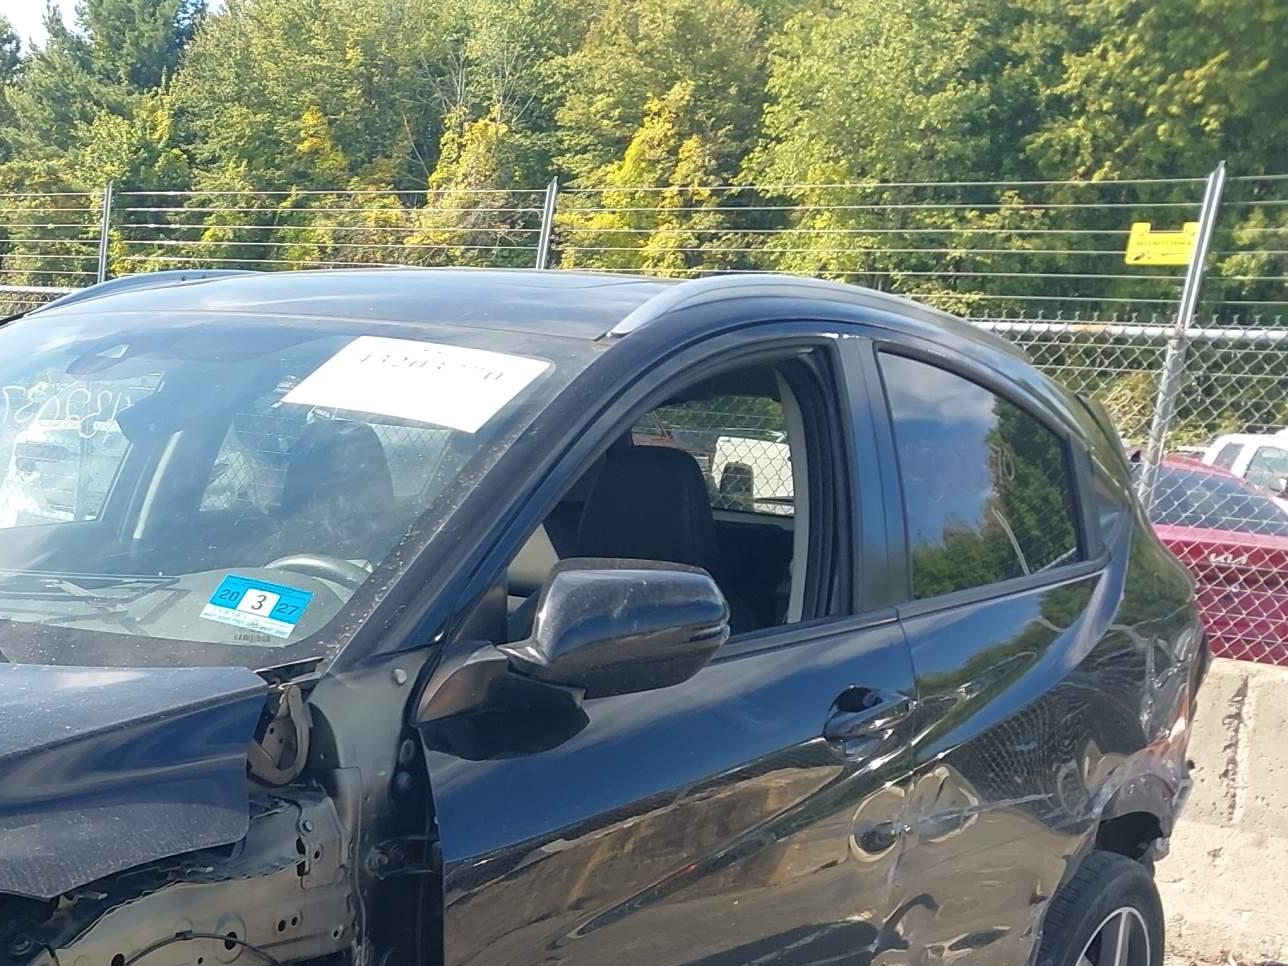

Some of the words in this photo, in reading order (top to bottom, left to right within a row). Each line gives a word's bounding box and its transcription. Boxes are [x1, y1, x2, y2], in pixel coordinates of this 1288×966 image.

[218, 588, 241, 602] 20
[250, 594, 268, 611] 3
[275, 602, 300, 616] 27
